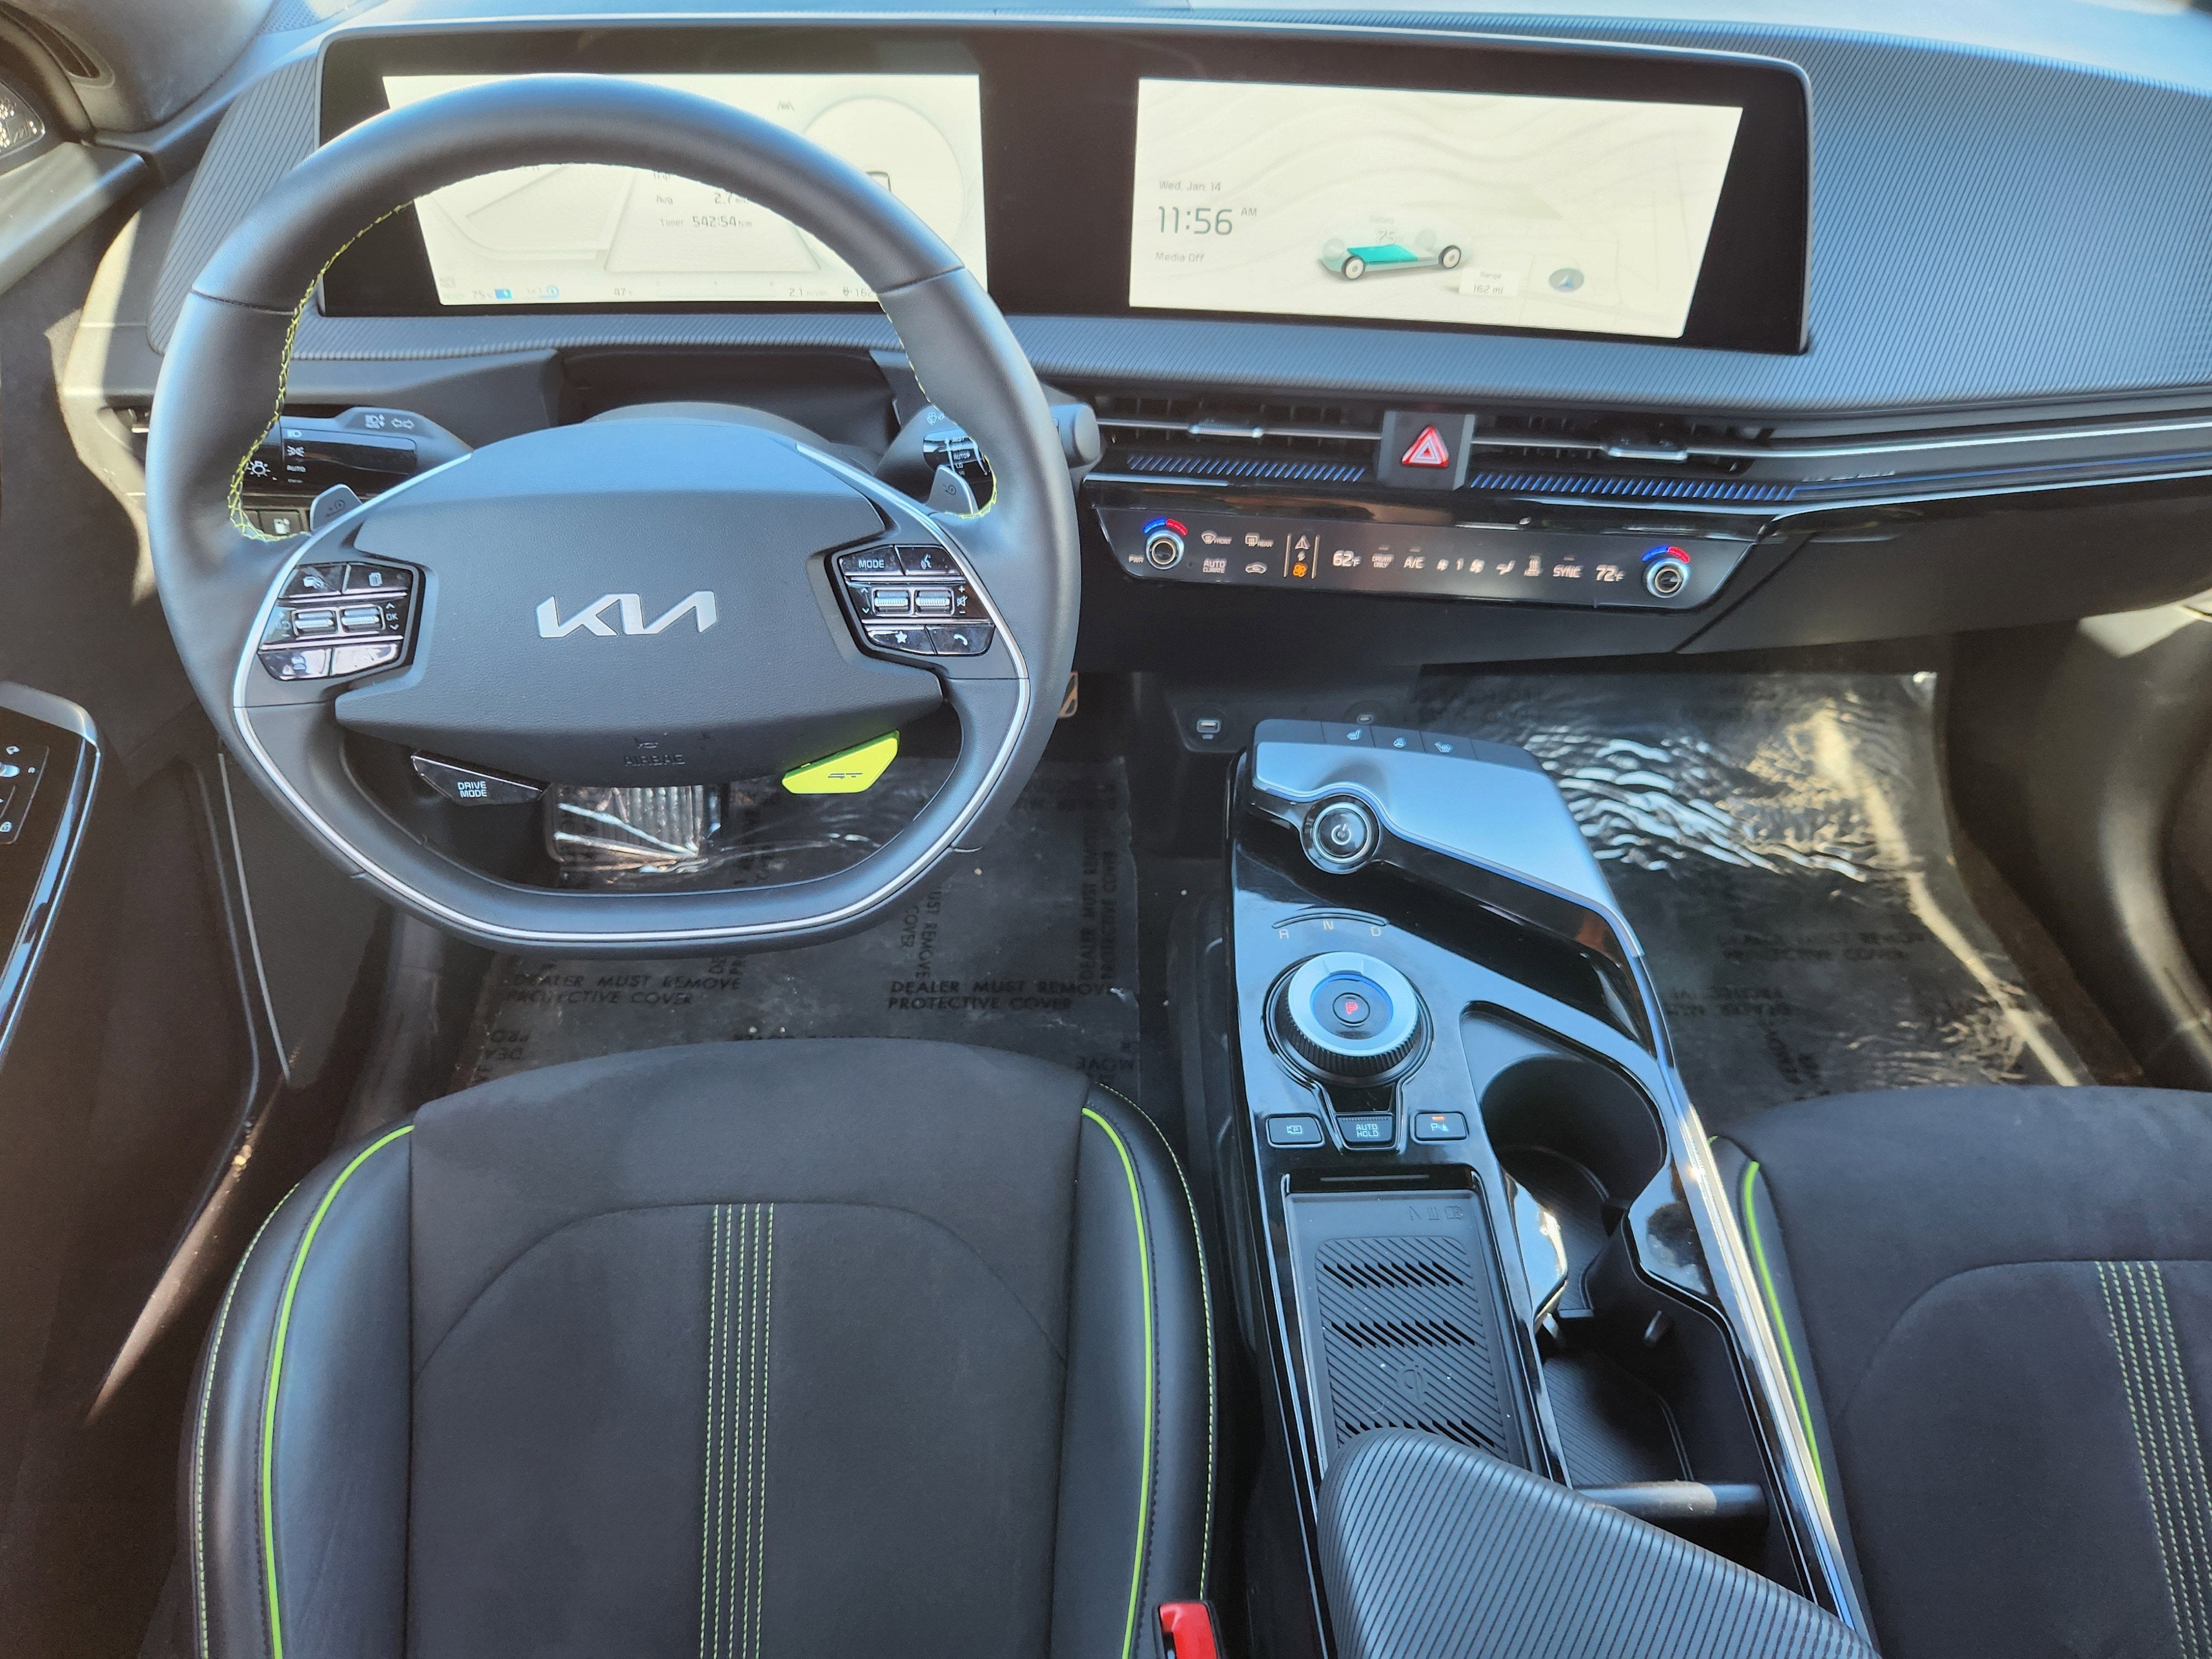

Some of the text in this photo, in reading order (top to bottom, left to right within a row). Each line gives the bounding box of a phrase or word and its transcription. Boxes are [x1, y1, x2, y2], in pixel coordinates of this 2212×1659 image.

[1211, 181, 1221, 192] 14
[692, 215, 737, 228] 542:54
[1158, 206, 1258, 236] 11:56 AM
[1155, 252, 1206, 263] Media Off
[789, 288, 804, 298] 2.1
[1473, 284, 1490, 294] 162
[953, 451, 968, 461] AUTO
[1213, 536, 1233, 545] FRONT
[1203, 558, 1227, 568] AUTO
[1371, 553, 1394, 562] DRIVER
[1404, 555, 1426, 569] A/C
[858, 559, 885, 569] MODE
[1552, 564, 1583, 578] SYNC
[385, 613, 399, 621] OK
[536, 591, 717, 638] KIA
[623, 754, 686, 766] AIRBAG
[457, 780, 487, 790] DRIVE
[459, 789, 488, 799] MODE
[1323, 920, 1334, 930] N
[915, 888, 941, 979] UST REMOVE
[1370, 926, 1381, 937] D
[597, 975, 653, 988] MUST
[662, 975, 742, 990] REMOVE
[890, 980, 959, 994] DEALER
[972, 980, 1026, 994] MUST
[630, 992, 693, 1005] COVER
[887, 996, 1073, 1010] PROTECTIVE COVER
[1345, 1002, 1358, 1015] P
